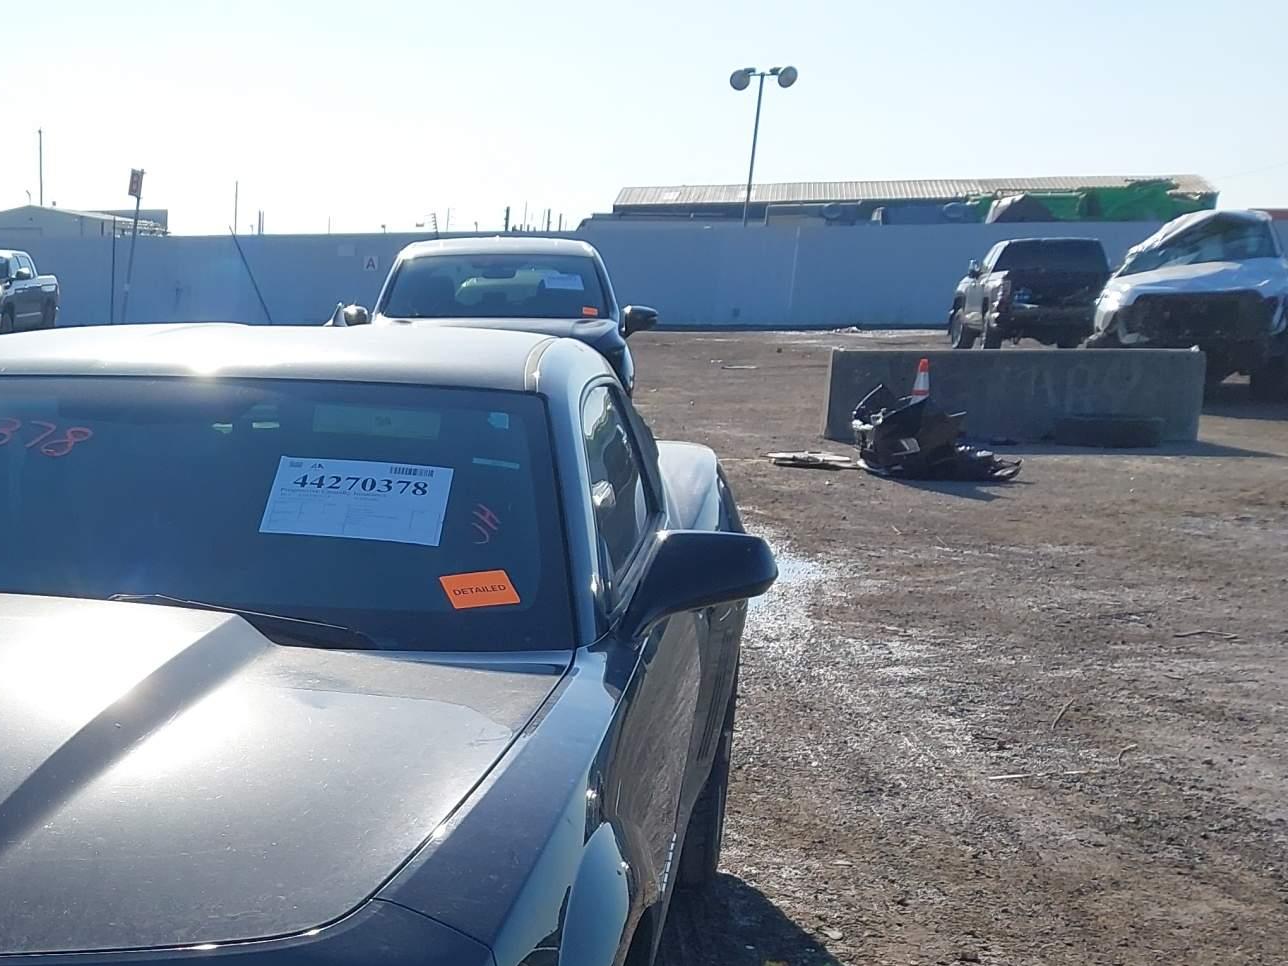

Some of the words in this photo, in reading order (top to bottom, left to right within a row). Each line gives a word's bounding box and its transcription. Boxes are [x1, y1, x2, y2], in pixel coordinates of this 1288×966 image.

[366, 257, 376, 270] A
[293, 474, 429, 496] 44270378
[452, 583, 507, 597] DETAILED
